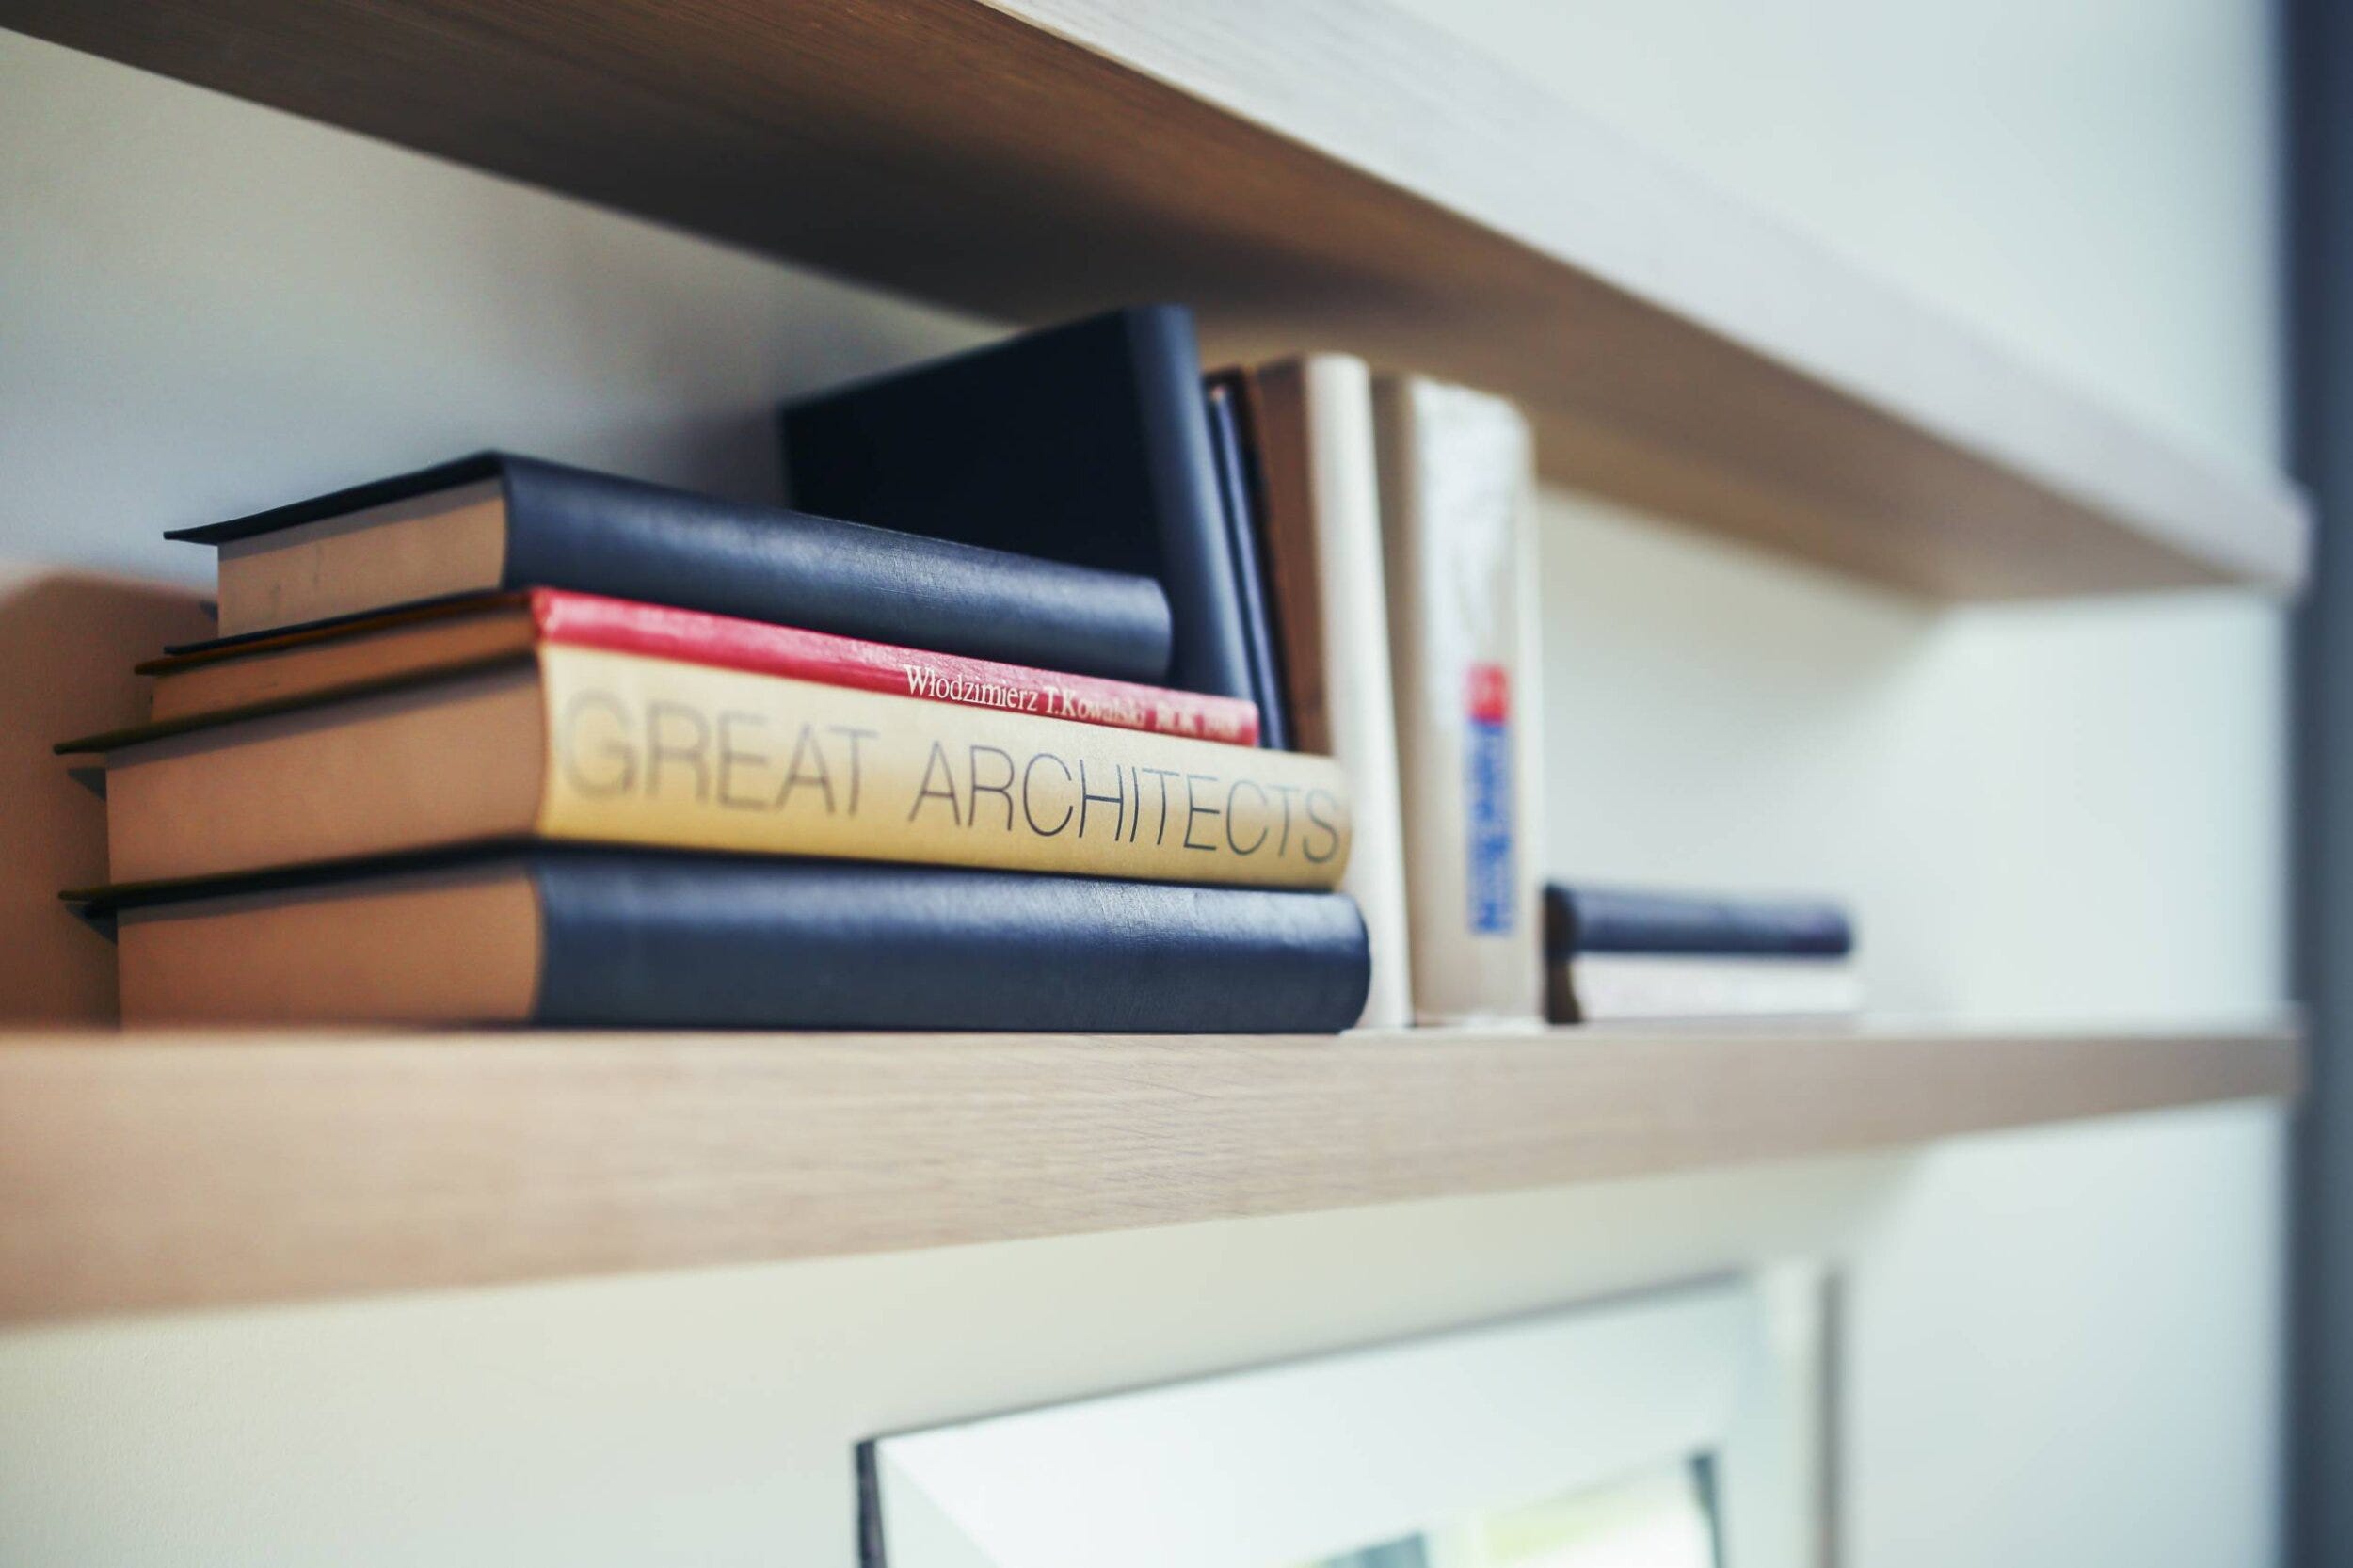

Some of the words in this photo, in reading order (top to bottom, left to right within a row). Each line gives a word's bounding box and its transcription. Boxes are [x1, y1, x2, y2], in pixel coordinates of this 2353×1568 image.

[904, 664, 1039, 712] Włodzimierz
[564, 688, 879, 817] GREAT
[907, 740, 1340, 864] ARCHITECTS
